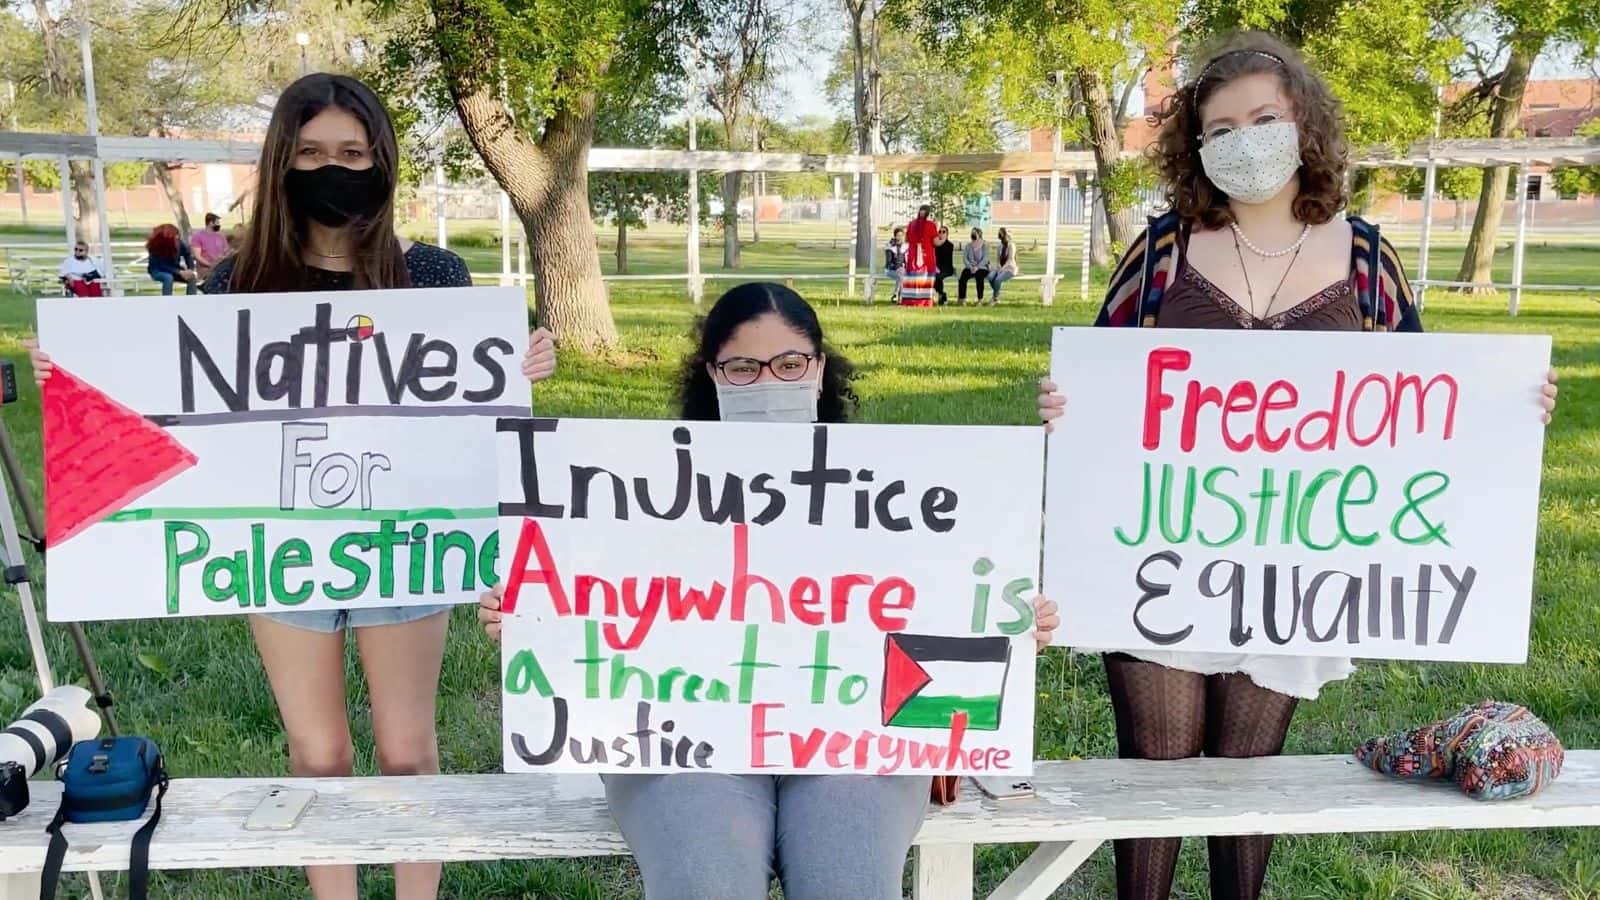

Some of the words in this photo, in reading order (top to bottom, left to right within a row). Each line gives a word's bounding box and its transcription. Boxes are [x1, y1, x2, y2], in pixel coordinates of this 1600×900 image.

[180, 304, 513, 412] Natives
[1143, 348, 1458, 452] Freedom
[280, 422, 390, 511] For
[497, 418, 958, 532] Injustice
[1390, 471, 1454, 547] &
[502, 517, 915, 649] Anywhere
[972, 557, 1033, 635] is
[506, 649, 554, 697] a
[574, 620, 781, 704] threat
[799, 630, 868, 704] to
[511, 697, 714, 768] Justice
[751, 703, 1012, 775] Everywhere
